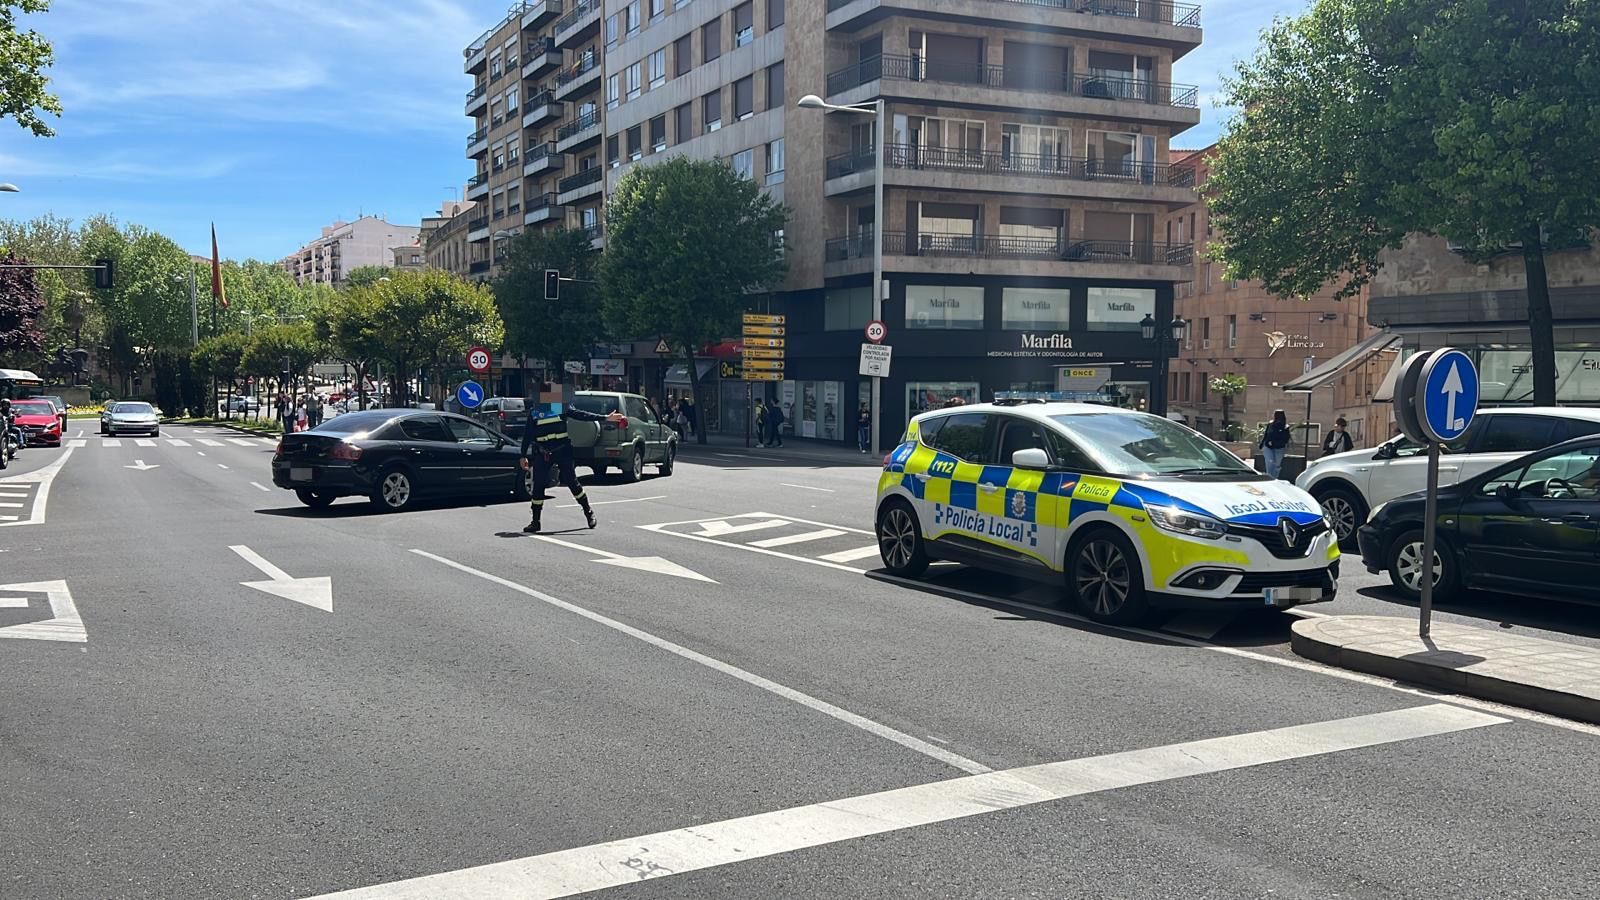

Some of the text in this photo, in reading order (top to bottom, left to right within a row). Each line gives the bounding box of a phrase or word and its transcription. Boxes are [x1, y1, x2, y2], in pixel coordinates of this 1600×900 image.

[929, 298, 960, 309] Marfila
[1021, 300, 1051, 310] Marfila
[1107, 302, 1135, 312] Marfila
[870, 327, 882, 336] 30
[1021, 333, 1073, 349] Marfila
[472, 355, 487, 364] 30
[936, 460, 955, 474] 112
[1078, 483, 1109, 497] Policía
[945, 506, 1024, 543] Policía Local
